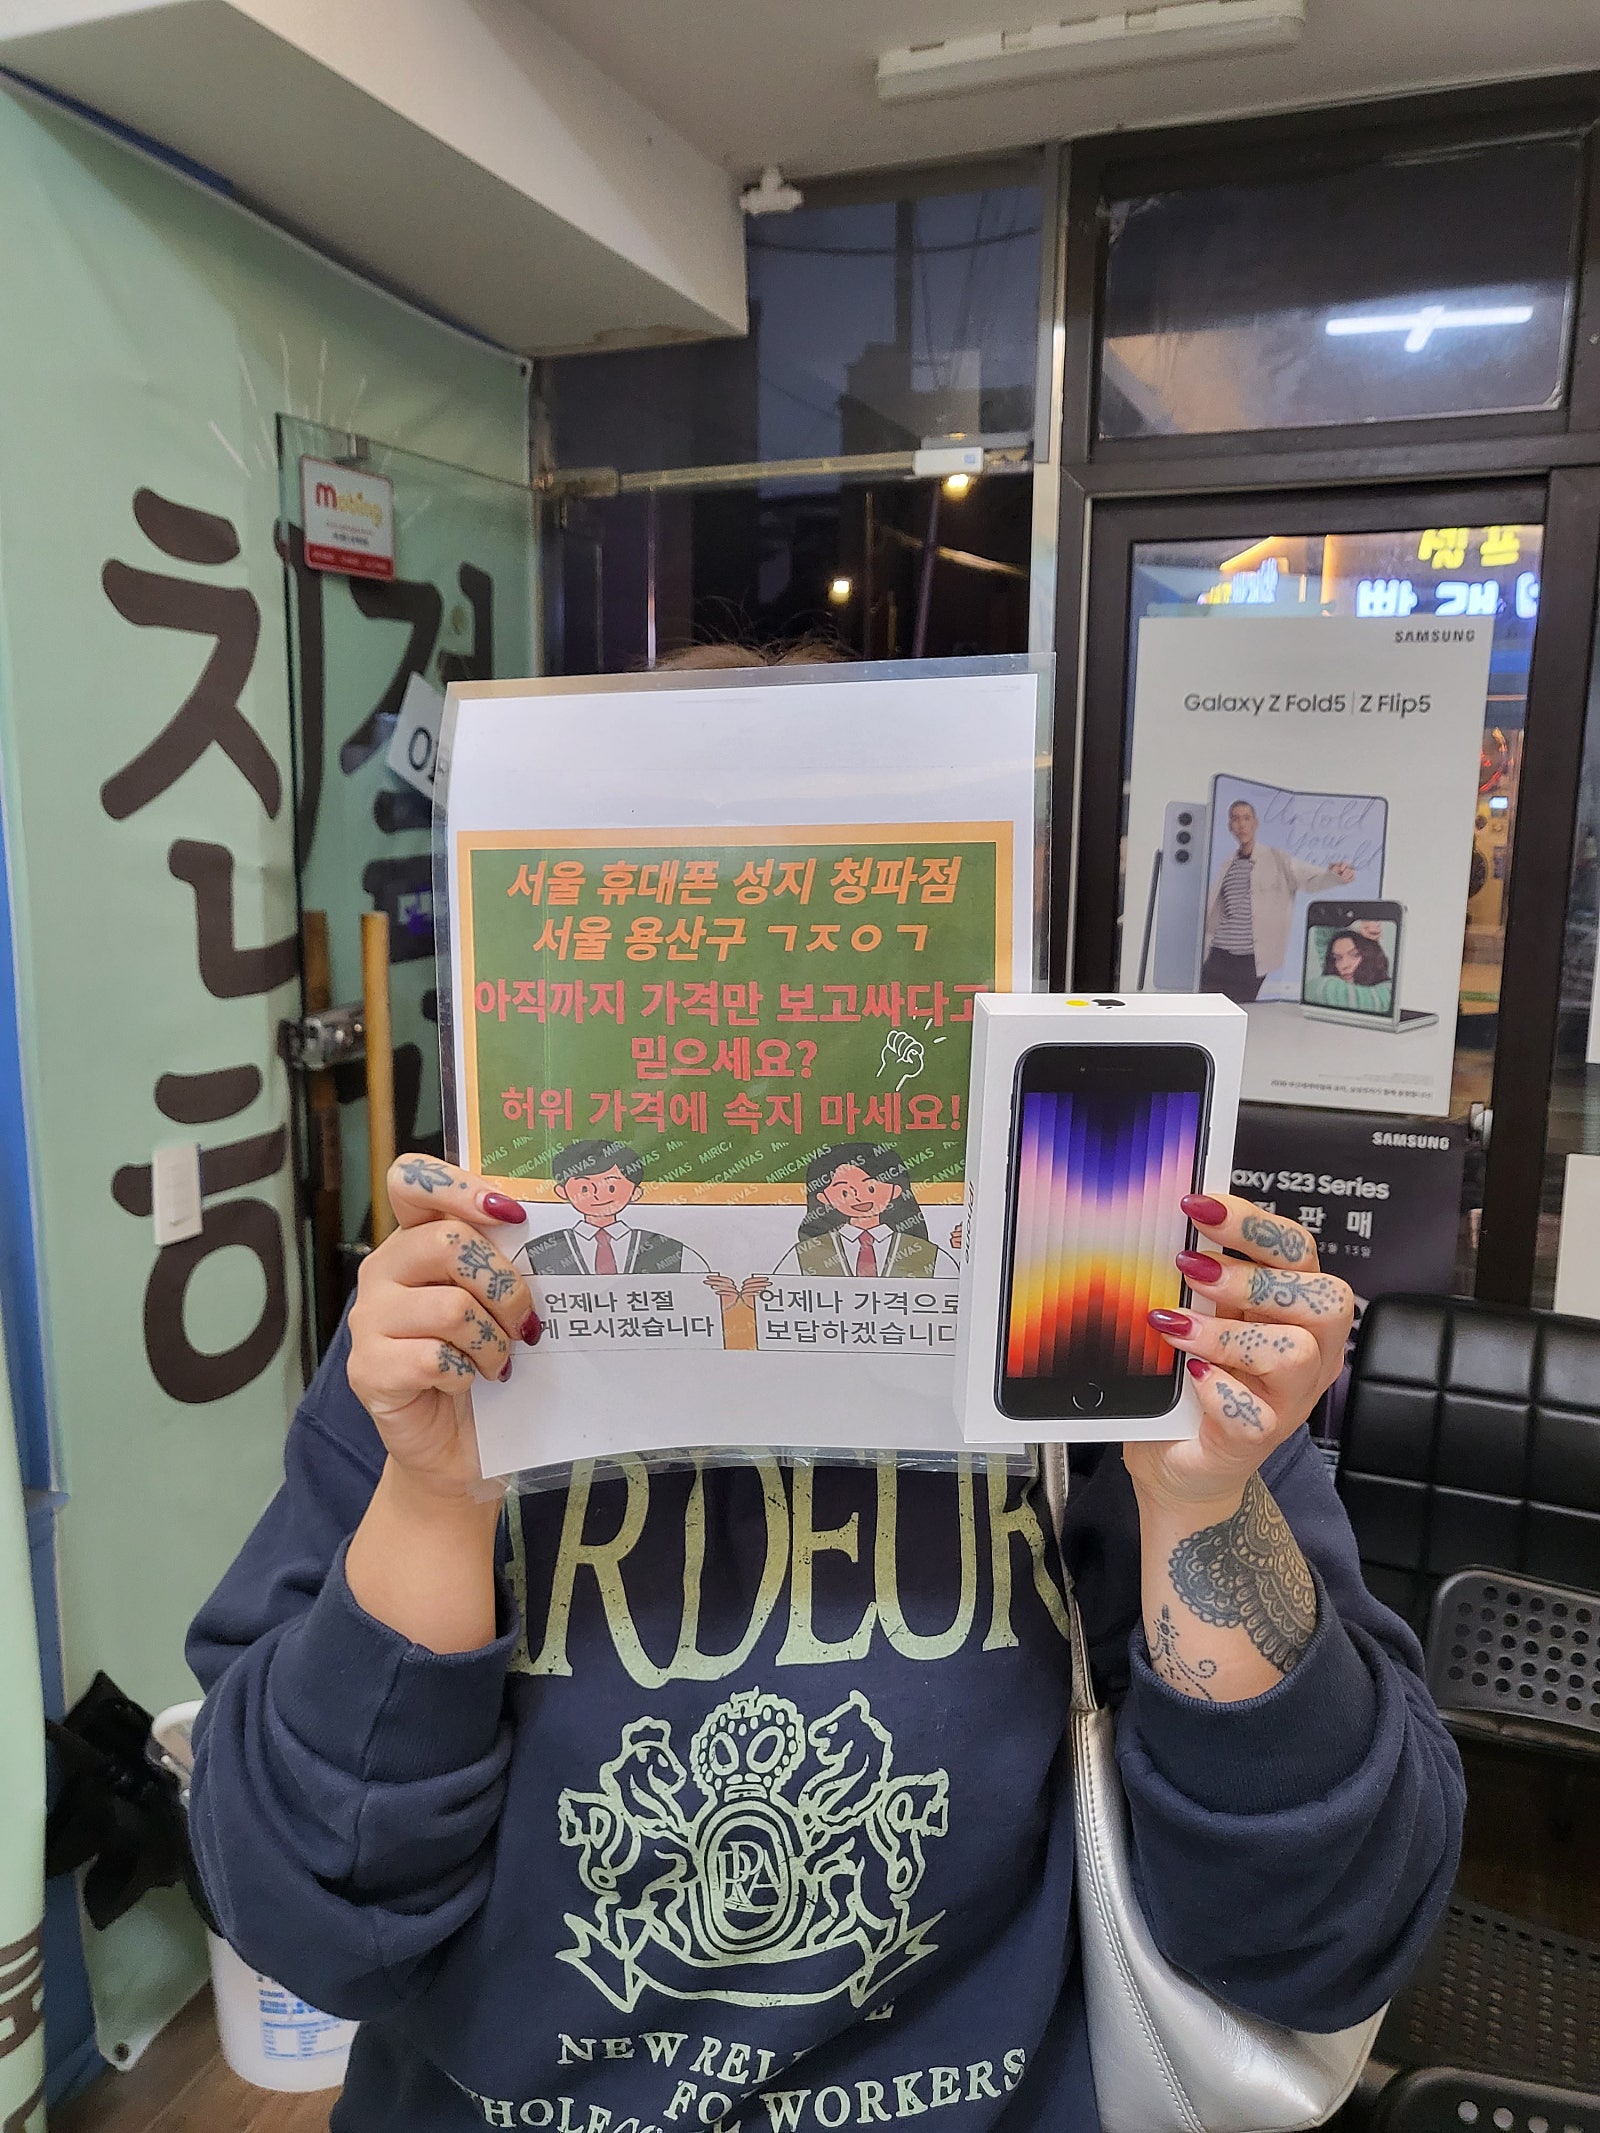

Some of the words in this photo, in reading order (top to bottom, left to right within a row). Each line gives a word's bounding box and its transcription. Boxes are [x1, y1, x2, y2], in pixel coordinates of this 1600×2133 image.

[1395, 629, 1475, 643] SAMSUNG
[1184, 693, 1264, 716] Galaxy
[1268, 694, 1280, 712] Z
[1285, 693, 1346, 712] Fold5
[1360, 694, 1372, 713] Z
[1377, 692, 1431, 718] Flip5
[507, 861, 586, 905] 서울
[597, 861, 718, 905] 휴대폰
[733, 858, 817, 905] 성지
[830, 856, 961, 904] 청파점
[533, 916, 612, 961] 서울
[624, 916, 746, 961] 용산구
[475, 979, 625, 1025] 아직까지
[641, 980, 764, 1026] 가격만
[631, 1035, 818, 1082] 믿으세요?
[501, 1087, 573, 1131] 허위
[589, 1089, 708, 1134] 가격에
[723, 1092, 803, 1135] 속지
[820, 1091, 961, 1135] 마세요!
[1372, 1131, 1450, 1151] SAMSUNG
[765, 1143, 832, 1184] MIRICANVAS
[1231, 1169, 1275, 1194] axy
[1277, 1171, 1316, 1194] S23
[1317, 1174, 1391, 1200] Series
[965, 1181, 976, 1264] iPhone
[545, 1291, 618, 1313] 언제나
[626, 1290, 675, 1312] 친절
[758, 1287, 844, 1315] 언제나
[540, 1318, 560, 1340] 게
[568, 1315, 715, 1340] 모시겠습니다
[556, 2031, 689, 2067] NEW
[758, 2047, 1026, 2133] WORKERS
